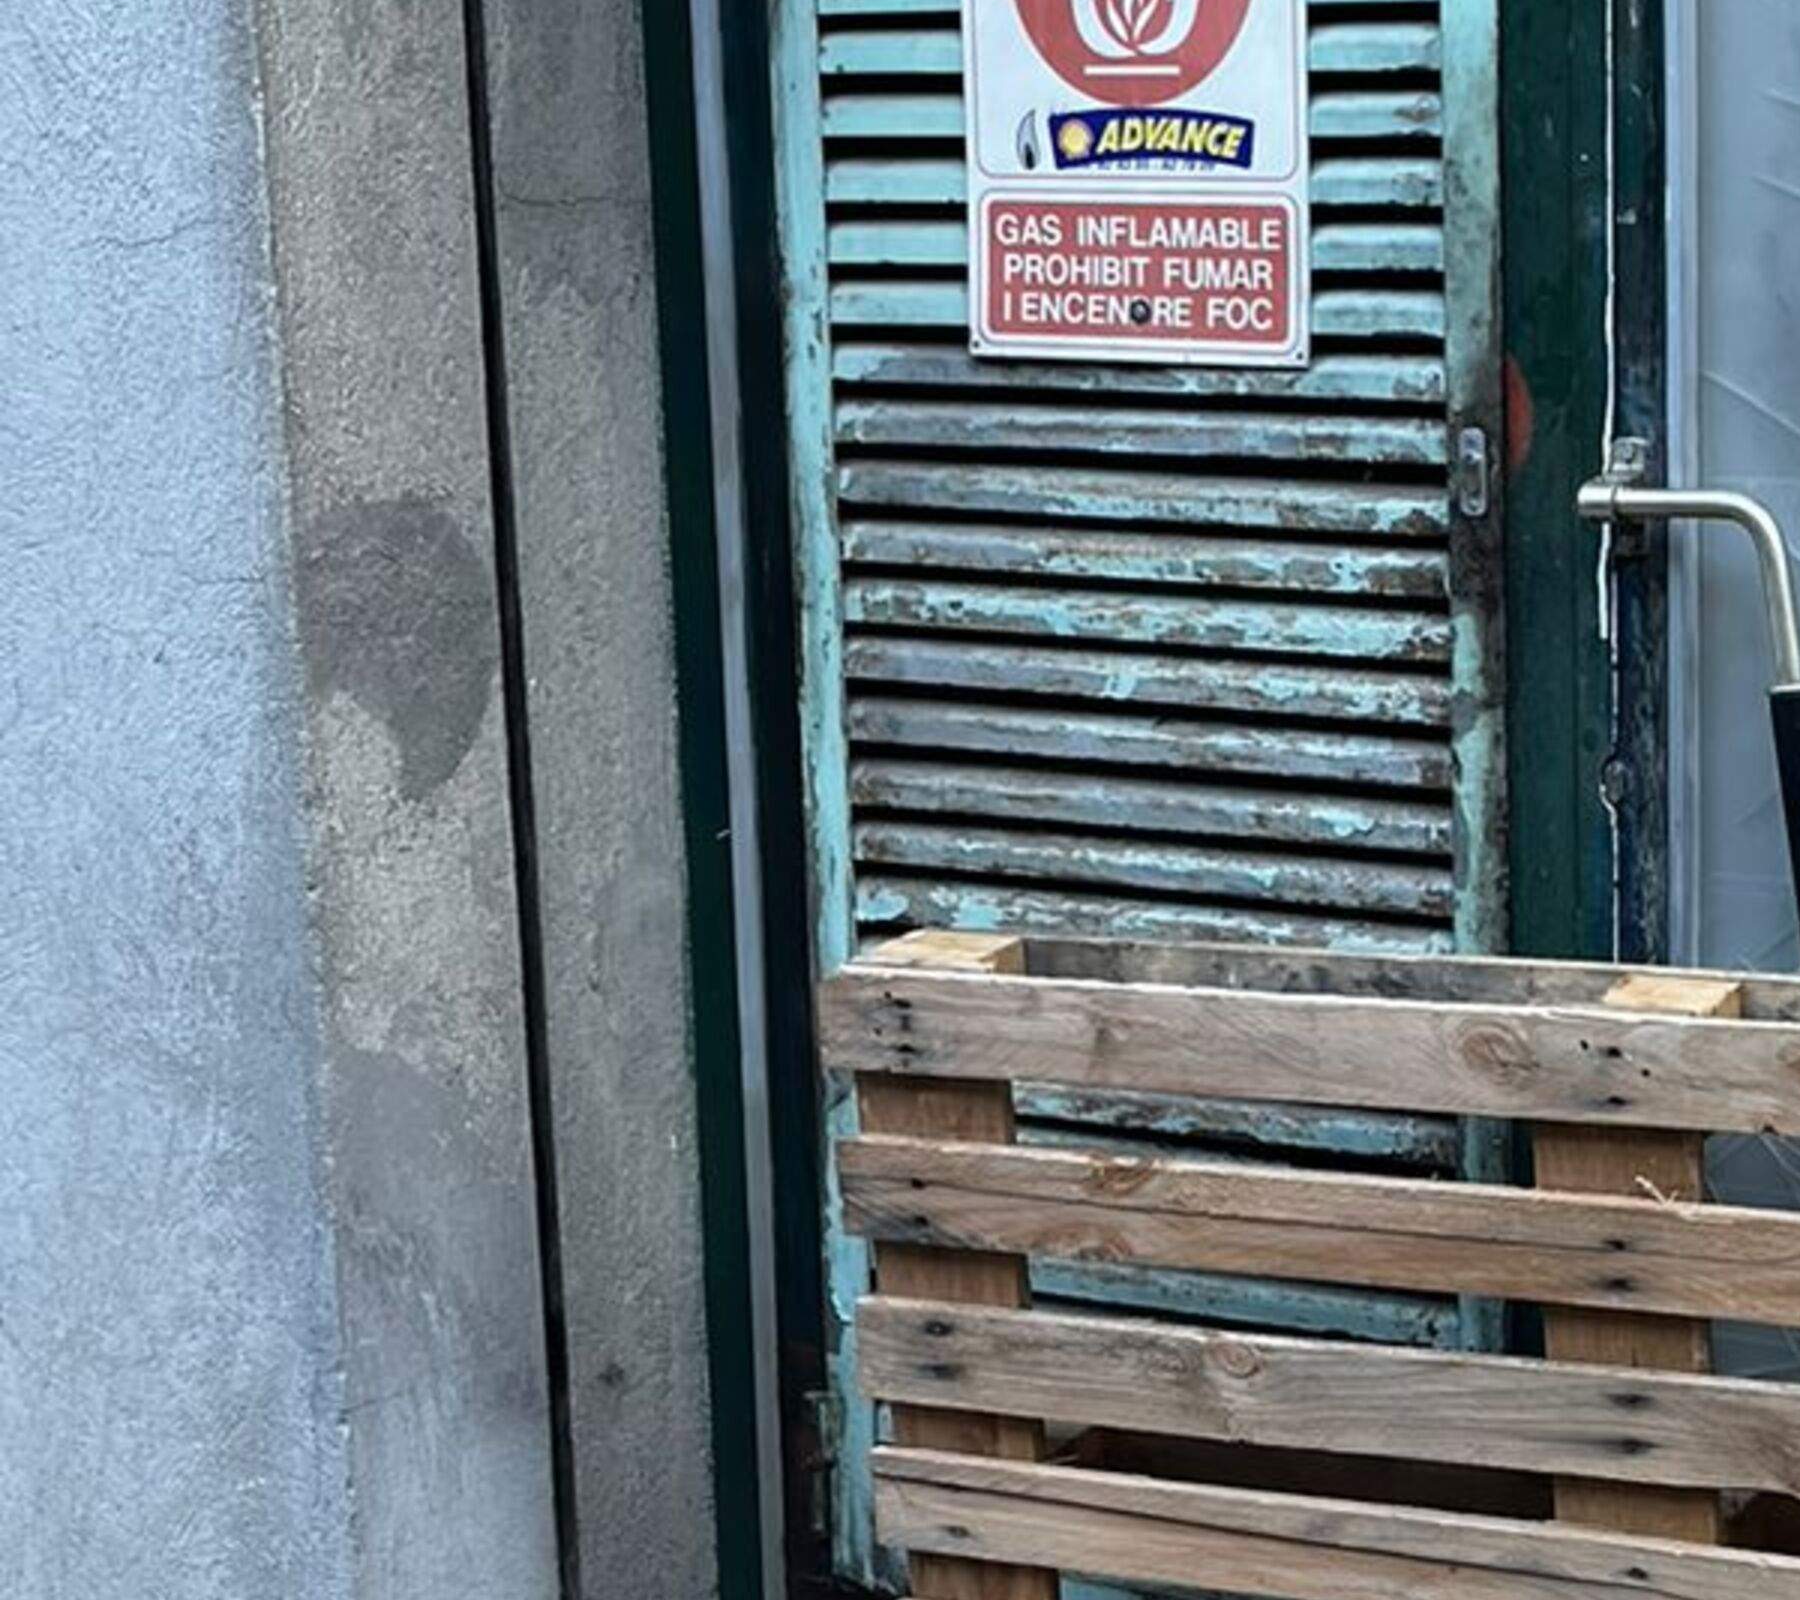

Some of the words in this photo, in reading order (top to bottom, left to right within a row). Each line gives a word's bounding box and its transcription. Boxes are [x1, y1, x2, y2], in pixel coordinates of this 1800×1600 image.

[1096, 118, 1245, 158] ADVANCE
[995, 213, 1062, 246] GAS
[1077, 215, 1281, 249] INFLAMABLE
[1003, 253, 1150, 288] PROHIBIT
[1163, 258, 1273, 290] FUMAR
[1003, 292, 1012, 322] I
[1020, 292, 1192, 328] ENCENRE
[1207, 297, 1273, 330] FOC
